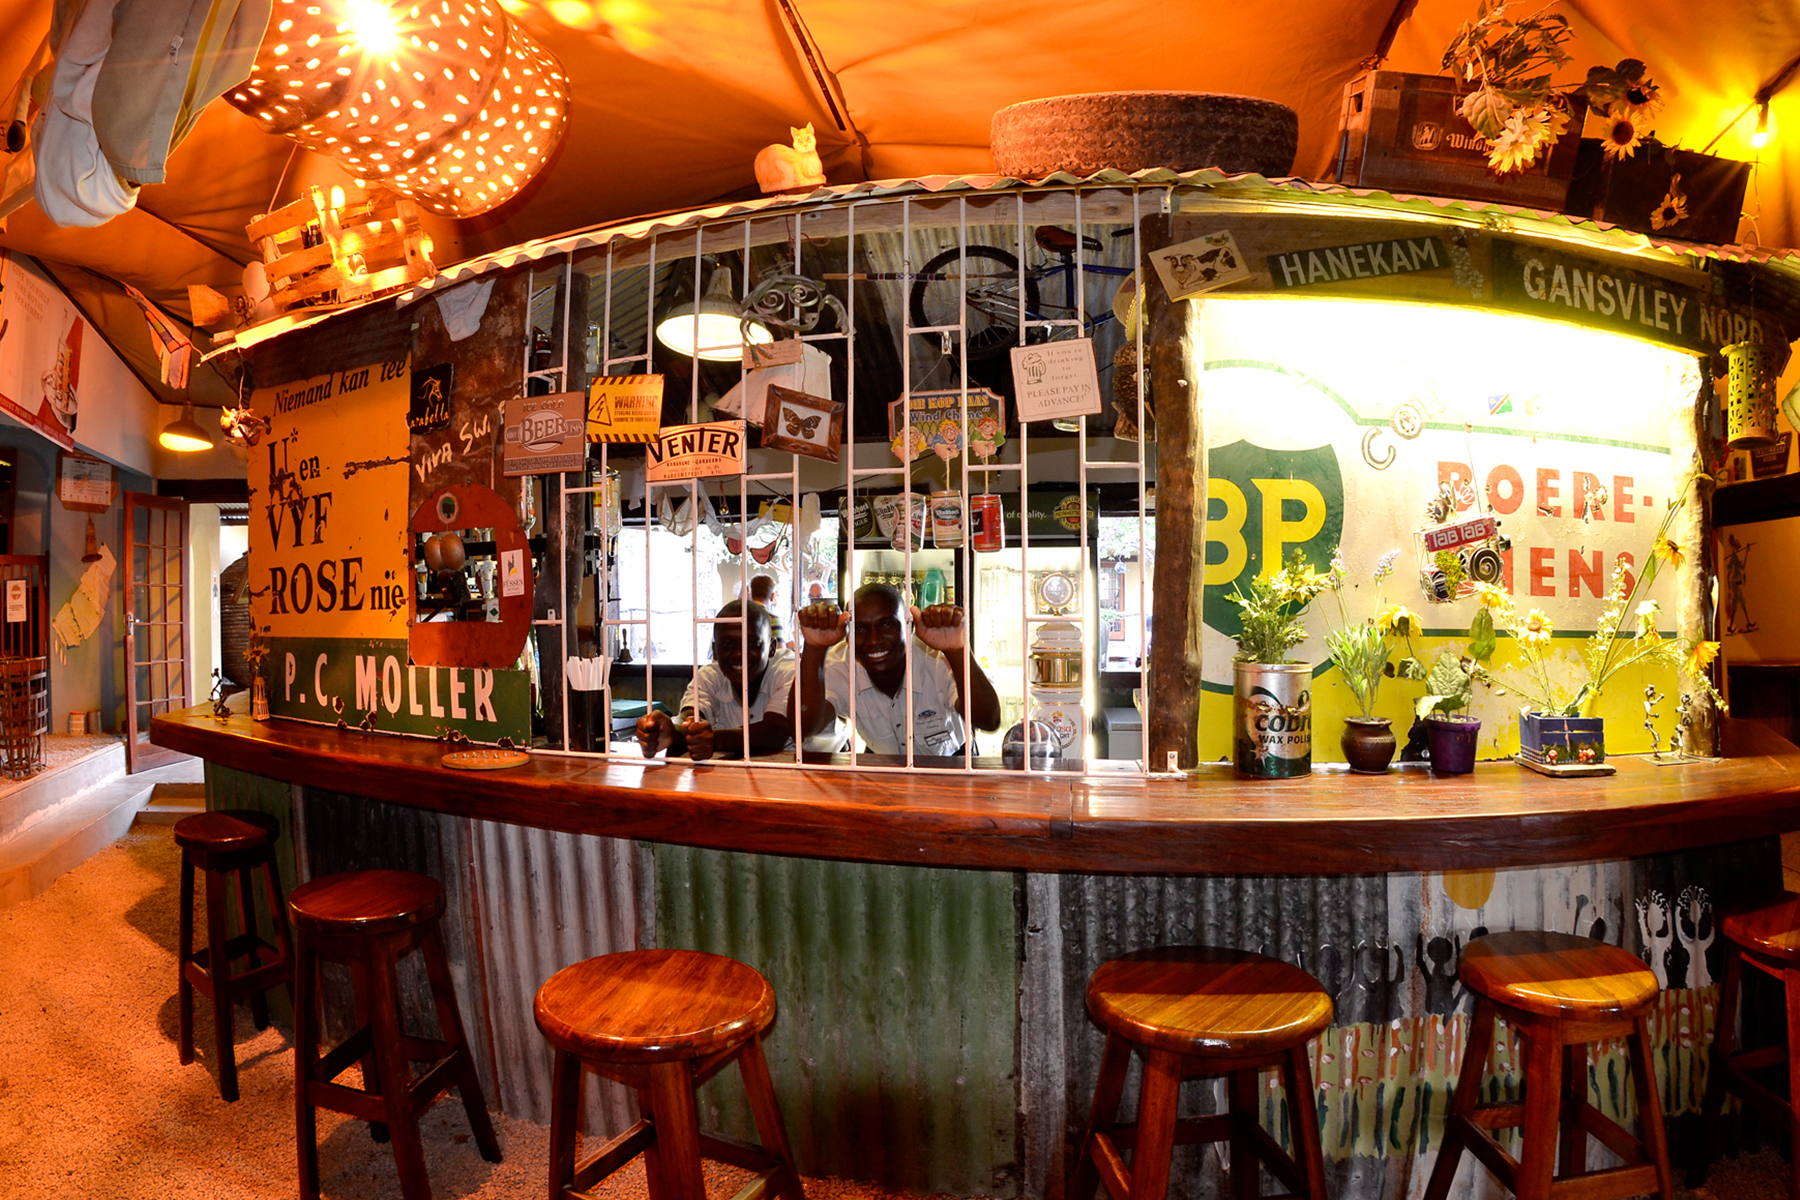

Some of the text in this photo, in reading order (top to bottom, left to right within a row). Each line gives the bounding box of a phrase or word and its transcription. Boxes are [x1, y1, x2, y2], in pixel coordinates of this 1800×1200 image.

[1279, 238, 1439, 287] HANEKAM
[1523, 258, 1687, 335] GANSVLEY
[1048, 356, 1083, 365] drinking
[273, 360, 405, 417] Niemand kan tee
[614, 394, 658, 409] WARNING
[908, 398, 925, 410] DIE
[929, 396, 955, 409] KOP
[1027, 383, 1091, 398] PLEASE PAY IN
[410, 402, 449, 428] arabella
[523, 399, 564, 412] ICE COLD
[521, 418, 566, 443] BEER
[647, 427, 740, 463] VENTER
[300, 455, 321, 481] en
[415, 442, 452, 483] VIVA
[265, 492, 333, 552] VYF
[1006, 510, 1015, 518] of
[1203, 478, 1327, 586] BP
[269, 557, 365, 615] ROSE
[1500, 546, 1636, 600] IENS
[355, 654, 498, 723] MOLLER
[1259, 735, 1283, 745] WAX
